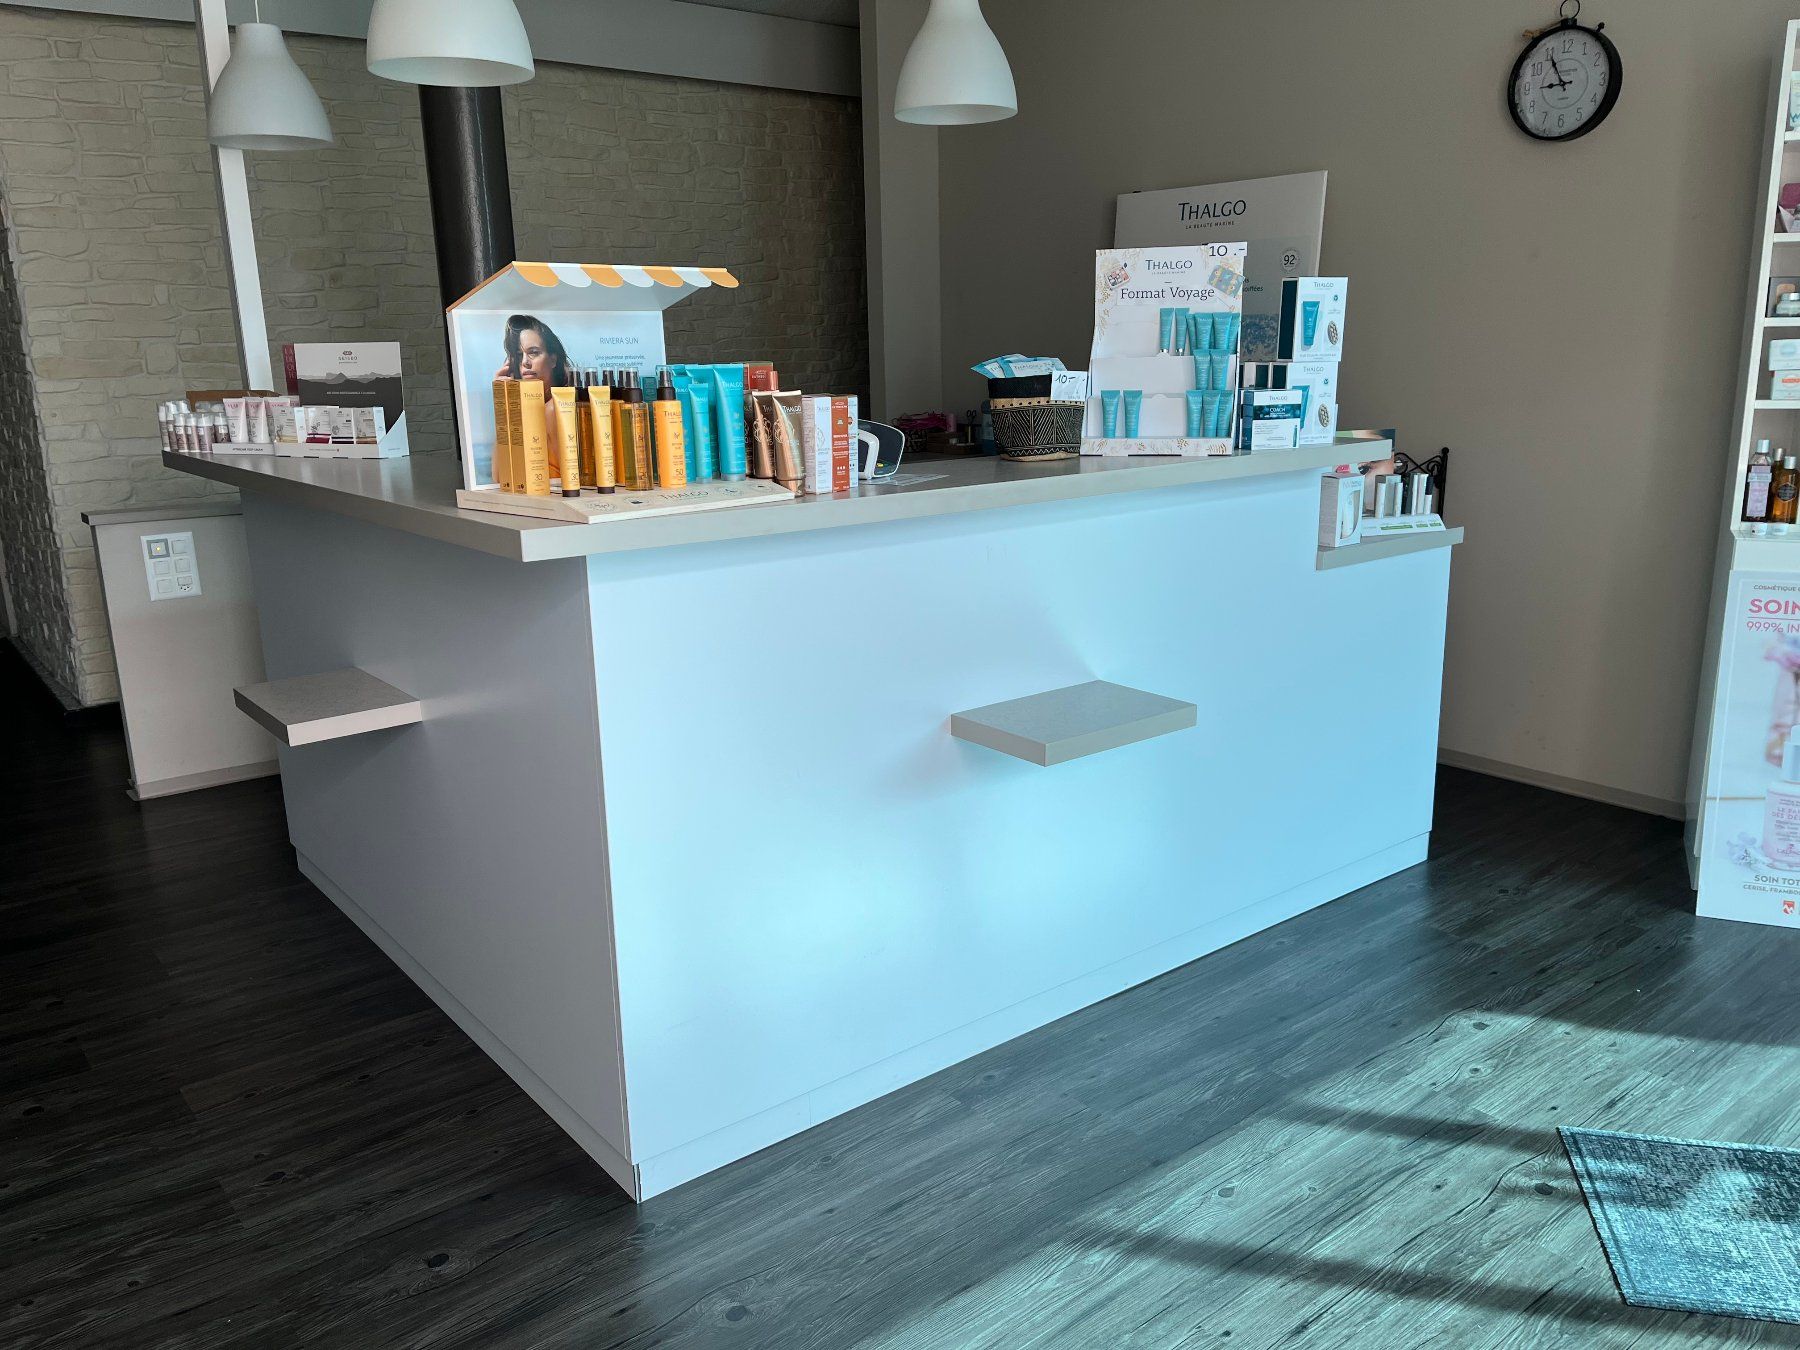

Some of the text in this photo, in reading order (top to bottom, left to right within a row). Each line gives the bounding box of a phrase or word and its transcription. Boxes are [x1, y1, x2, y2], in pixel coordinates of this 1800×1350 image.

[1561, 39, 1574, 53] 12
[1581, 41, 1588, 55] 1
[1593, 51, 1601, 67] 2
[1531, 61, 1543, 77] 10
[1599, 71, 1607, 87] 3
[1524, 82, 1530, 96] 9
[1590, 92, 1598, 106] 4
[1529, 100, 1535, 114] 8
[1575, 107, 1583, 121] 5
[1541, 111, 1549, 125] 7
[1557, 113, 1565, 128] 6
[1178, 200, 1247, 221] THALGO
[1208, 245, 1228, 257] 10
[1145, 259, 1193, 271] THALGO
[1283, 254, 1296, 266] 92
[1120, 287, 1215, 301] Format Voyage
[599, 337, 639, 345] RIVIERA SUN
[783, 405, 802, 413] THALGO
[534, 473, 543, 481] 30
[675, 468, 684, 476] 50
[1753, 584, 1797, 592] COSMÉTIQUE
[1754, 875, 1779, 884] SOIN
[1743, 884, 1769, 893] CERISE,
